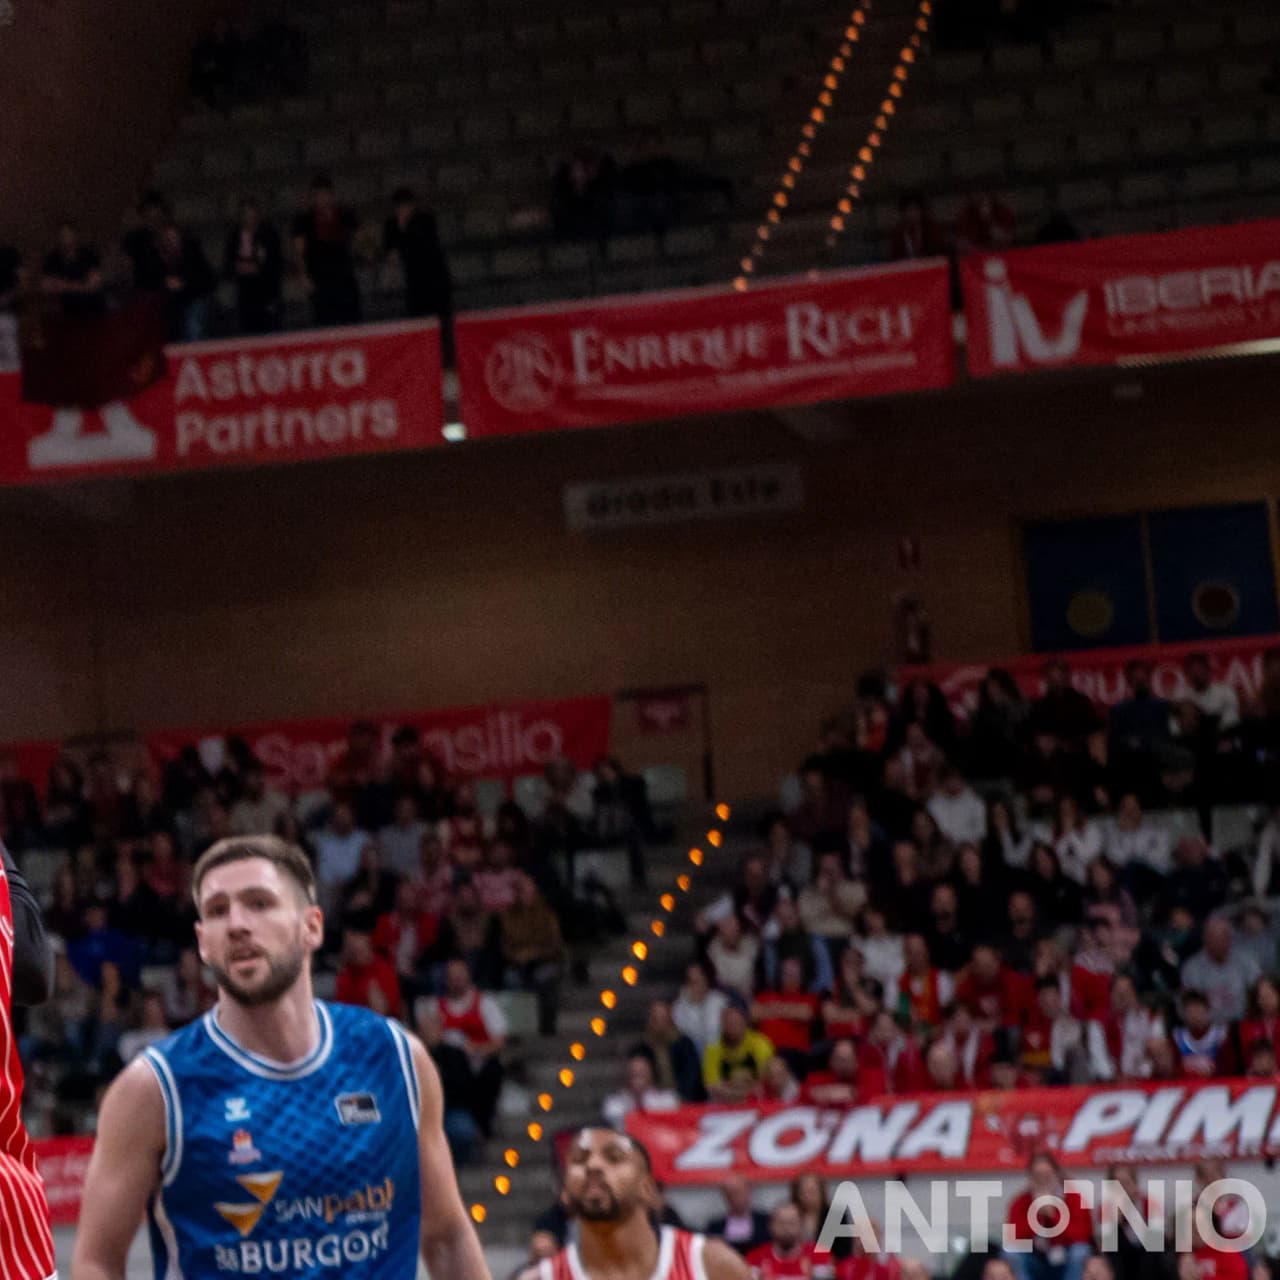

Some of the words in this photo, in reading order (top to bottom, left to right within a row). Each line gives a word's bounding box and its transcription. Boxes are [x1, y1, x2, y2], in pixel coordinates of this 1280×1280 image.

[174, 347, 369, 405] Asterra
[176, 399, 400, 456] Partners
[675, 1099, 974, 1168] ZONA
[1062, 1084, 1280, 1158] PIM
